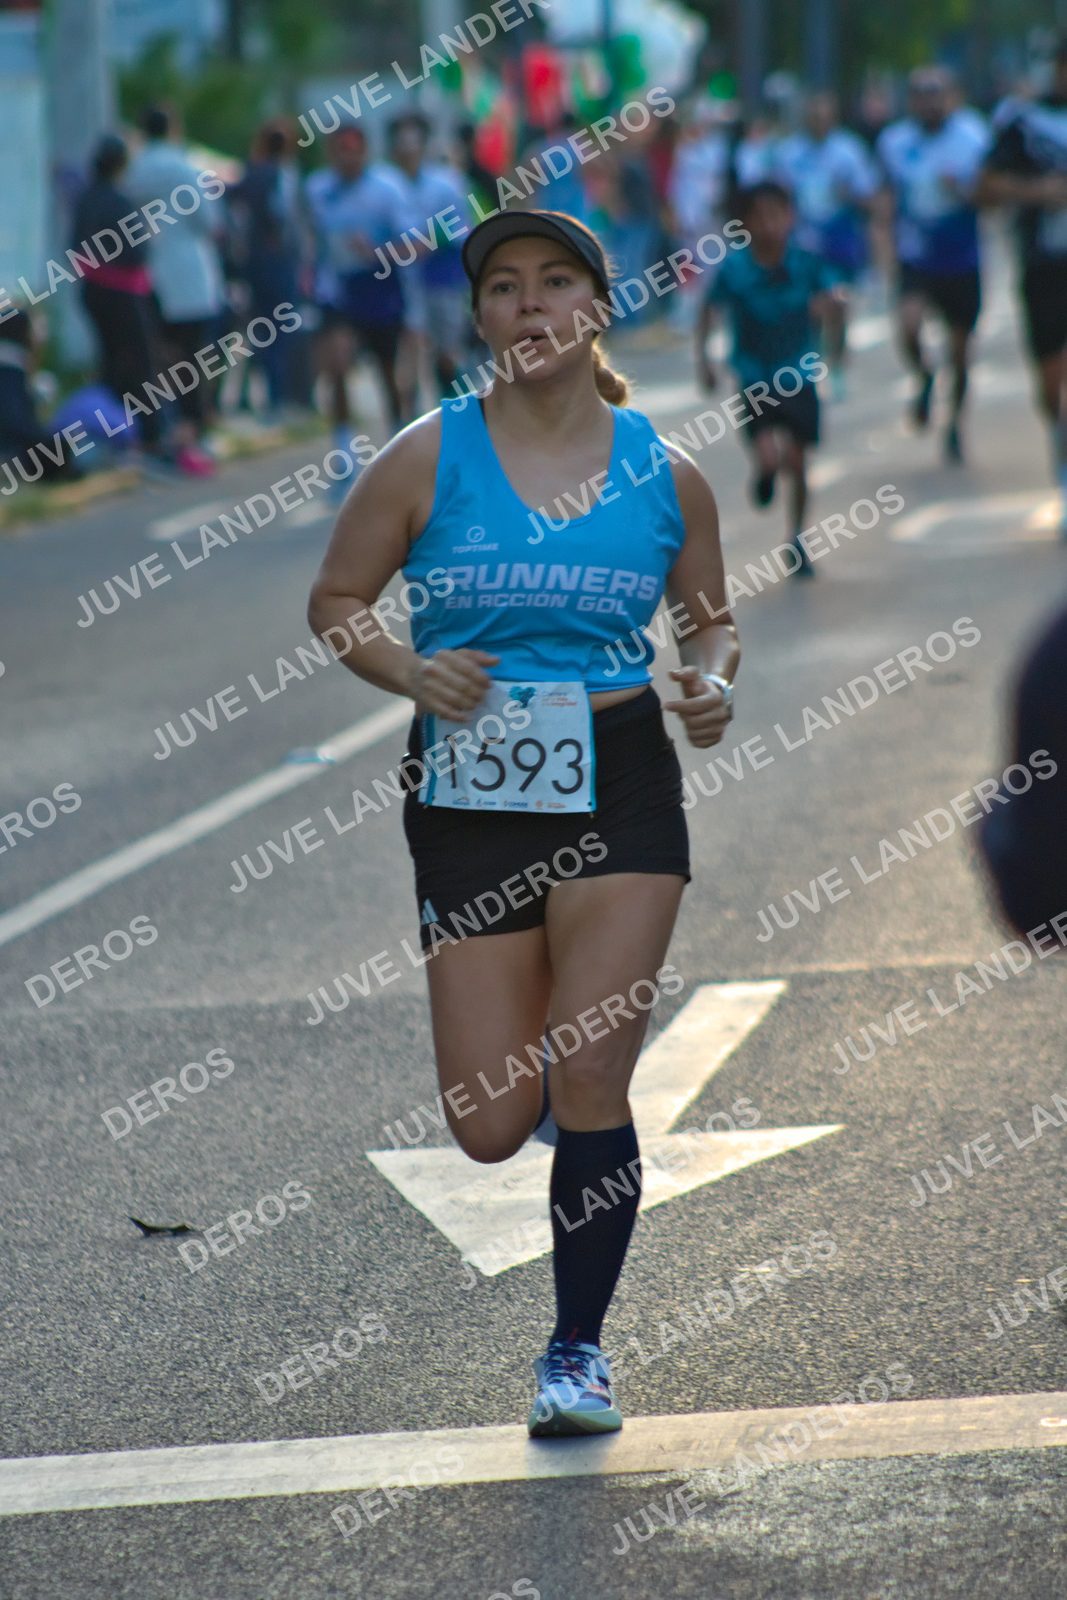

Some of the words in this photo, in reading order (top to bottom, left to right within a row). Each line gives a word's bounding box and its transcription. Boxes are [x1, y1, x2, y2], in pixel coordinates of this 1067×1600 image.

[448, 563, 658, 600] RUNNERS
[445, 595, 473, 609] EN
[576, 595, 629, 615] GDL
[445, 735, 584, 795] 1593
